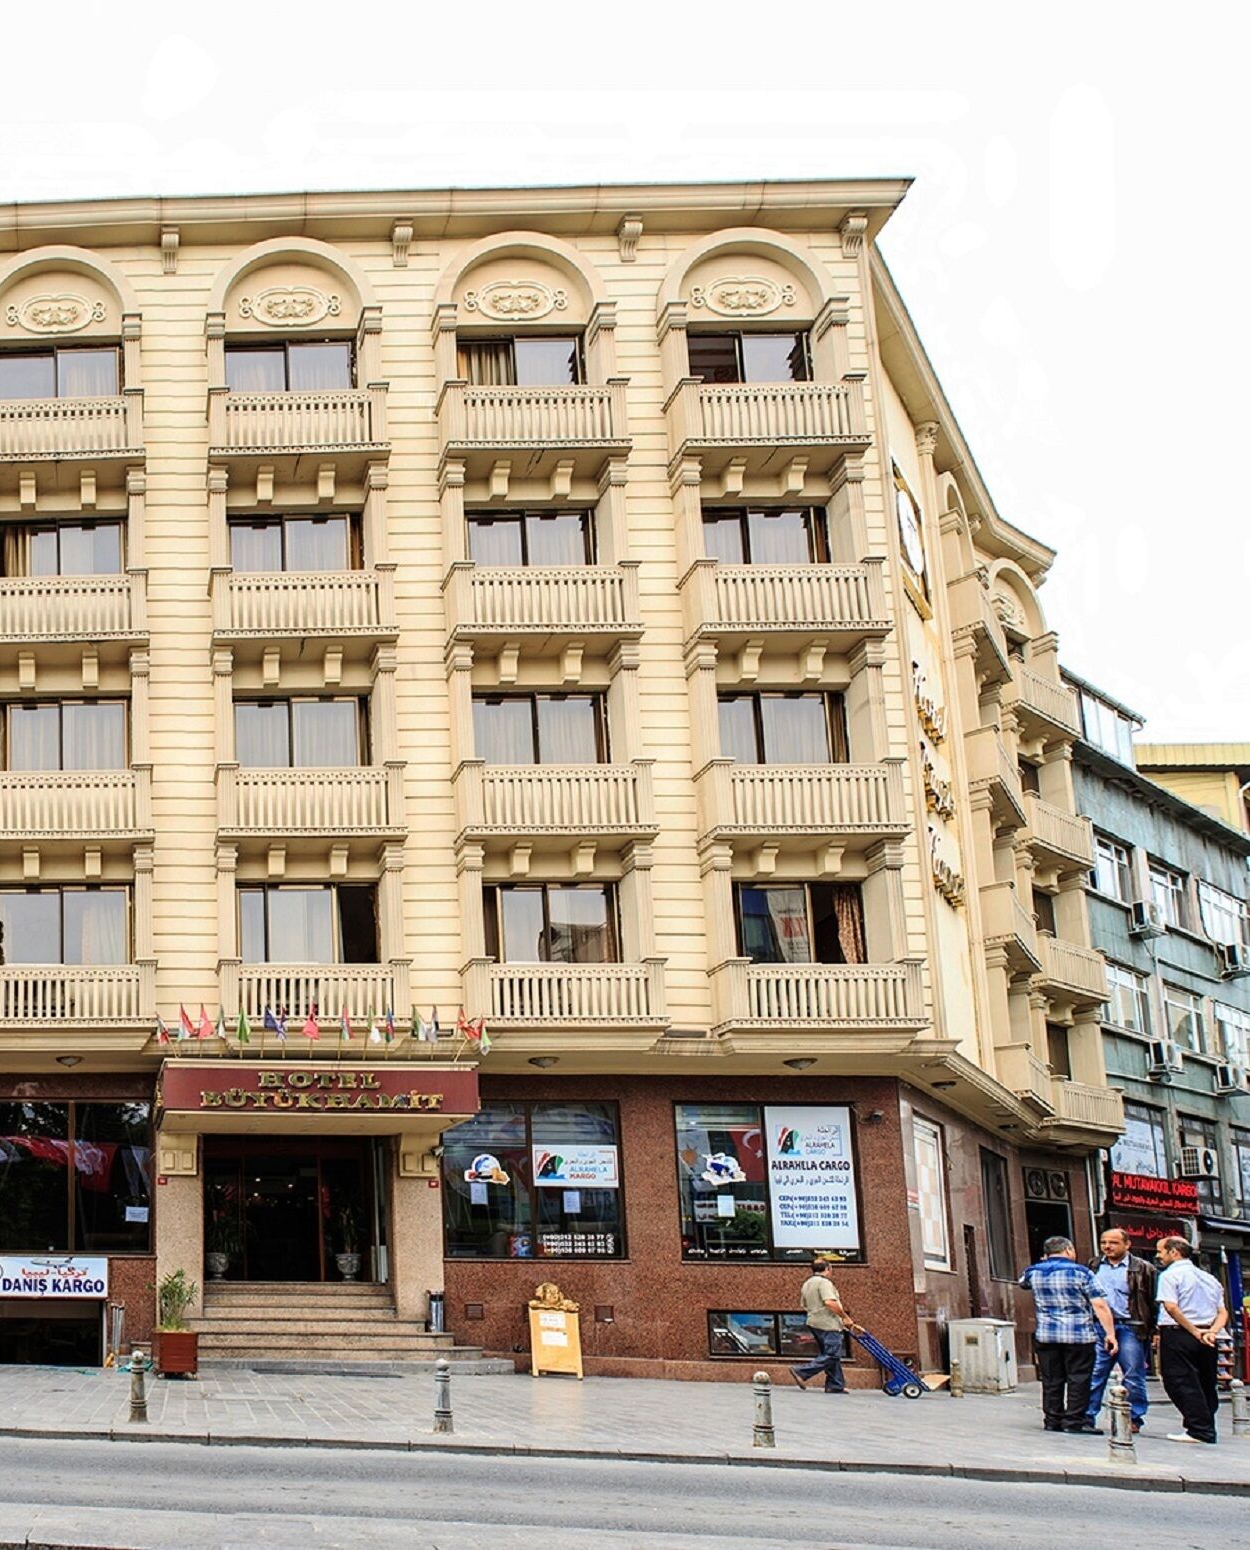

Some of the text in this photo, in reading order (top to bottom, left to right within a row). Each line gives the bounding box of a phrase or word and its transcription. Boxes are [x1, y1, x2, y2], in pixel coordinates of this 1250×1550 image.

[258, 1072, 381, 1089] HOTEL
[771, 1160, 850, 1170] ALRAHELA CARGO
[2, 1278, 105, 1295] DANIŞ KARGO
